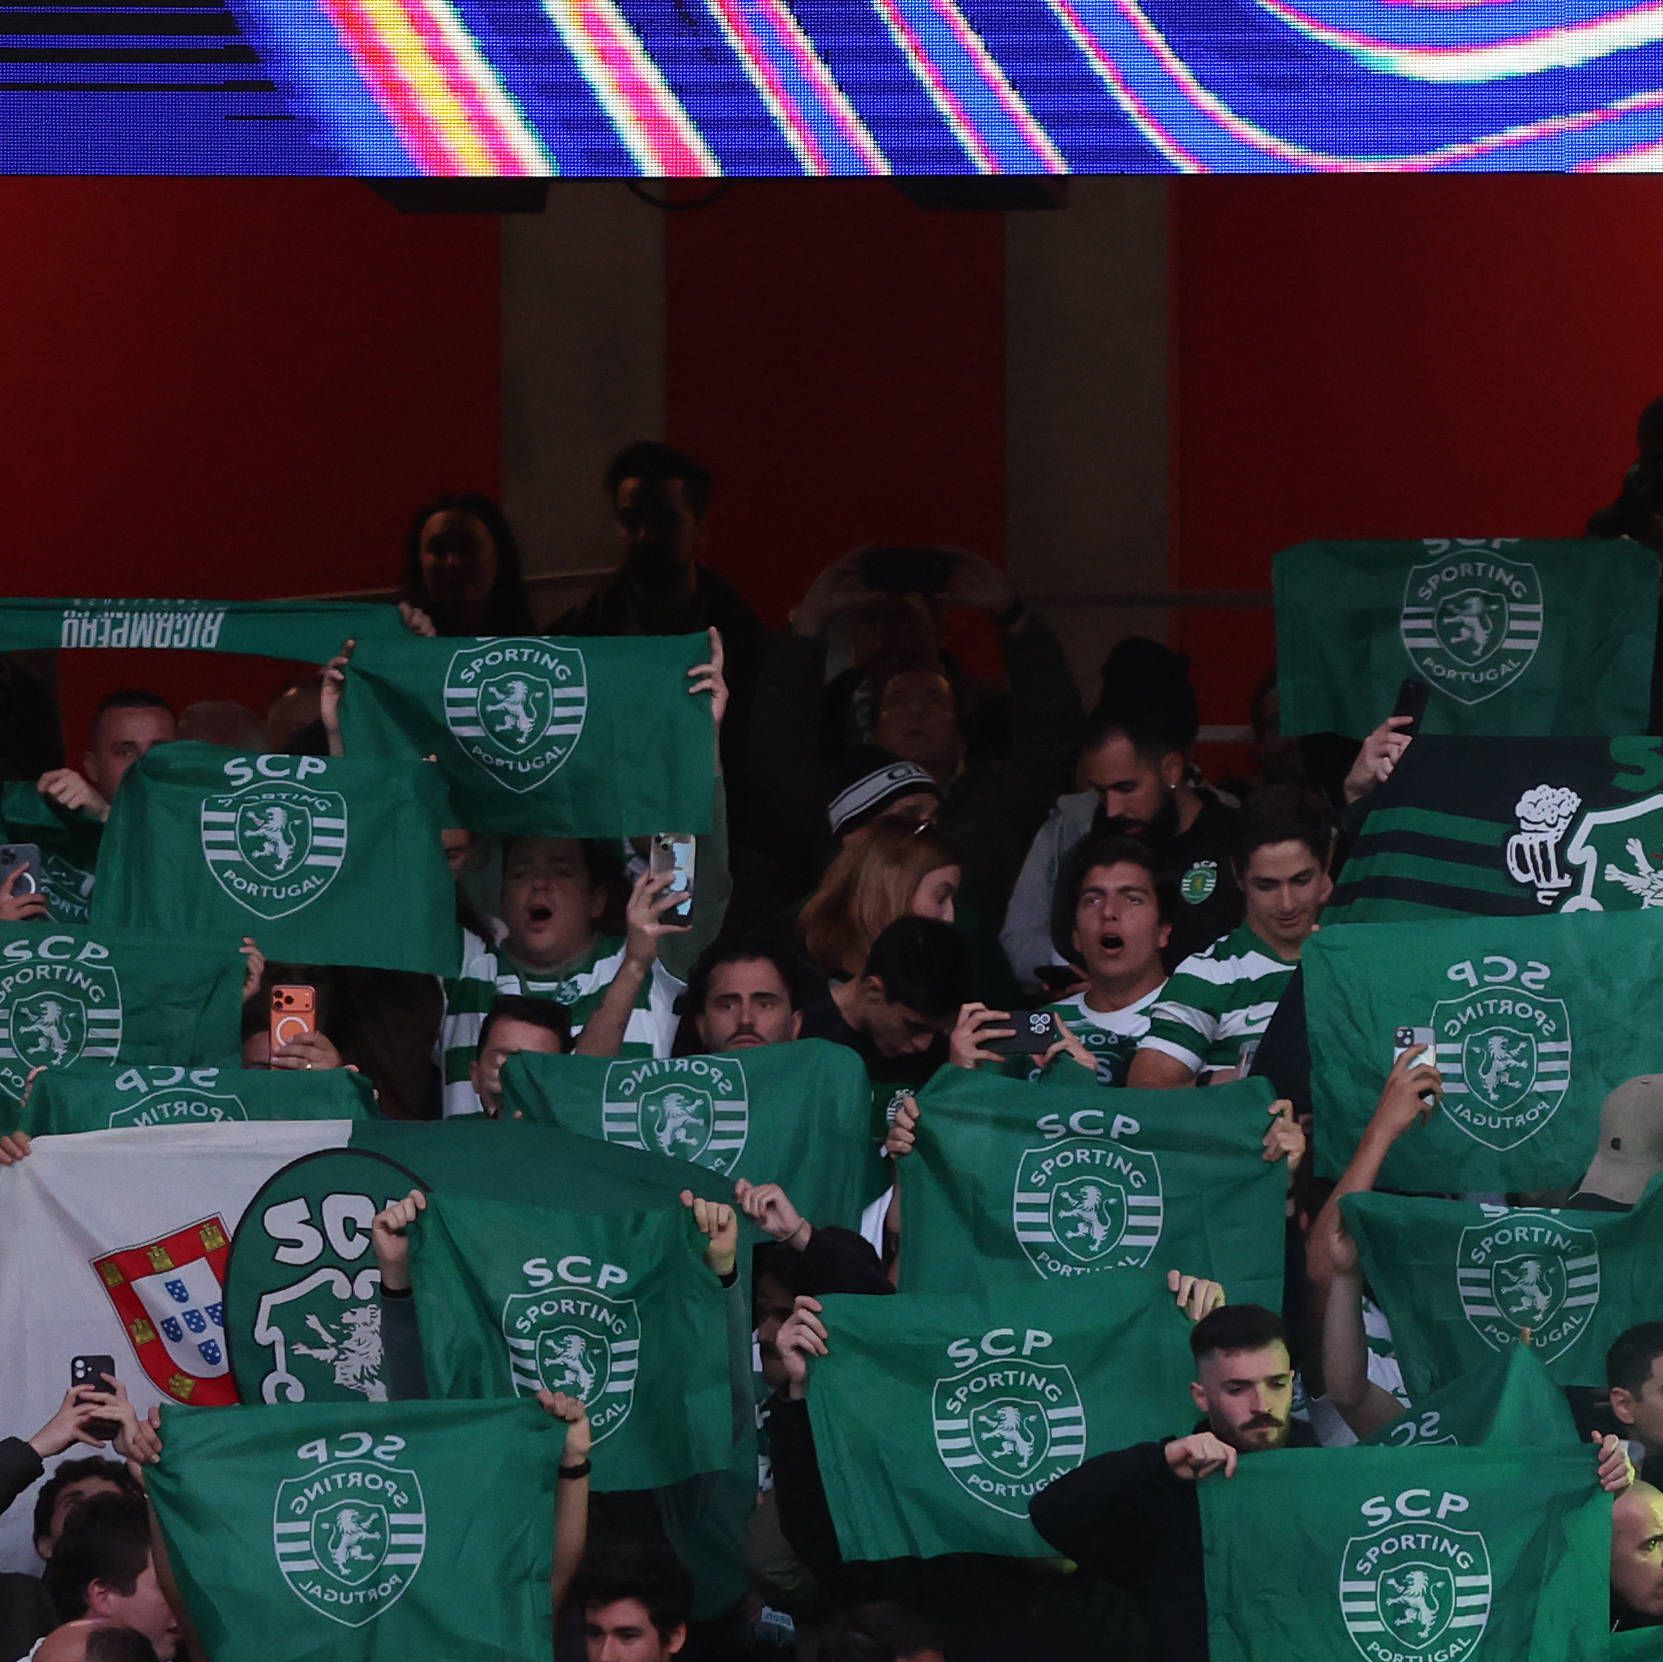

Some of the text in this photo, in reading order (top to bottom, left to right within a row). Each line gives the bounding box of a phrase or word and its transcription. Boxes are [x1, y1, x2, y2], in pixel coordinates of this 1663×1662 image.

[1418, 564, 1527, 600] SPORTING
[458, 648, 572, 686] SPORTING
[1422, 656, 1521, 684] PORTUGAL
[223, 754, 329, 788] SCP
[471, 742, 567, 774] PORTUGAL
[222, 872, 326, 899] PORTUGAL
[0, 936, 111, 964] SCP
[1036, 1109, 1142, 1141] SCP
[1030, 1149, 1148, 1189] SPORTING
[257, 1192, 402, 1264] SC
[1469, 1225, 1577, 1266] SPORTING
[522, 1255, 628, 1289] SCP
[1036, 1249, 1144, 1279] PORTAL
[516, 1300, 626, 1336] SPORTING
[1484, 1311, 1584, 1350] POUGAL
[947, 1328, 1054, 1370] SCP
[946, 1370, 1062, 1414] SPORTING
[1361, 1489, 1470, 1528] SCP
[1356, 1533, 1475, 1576] SPORTING
